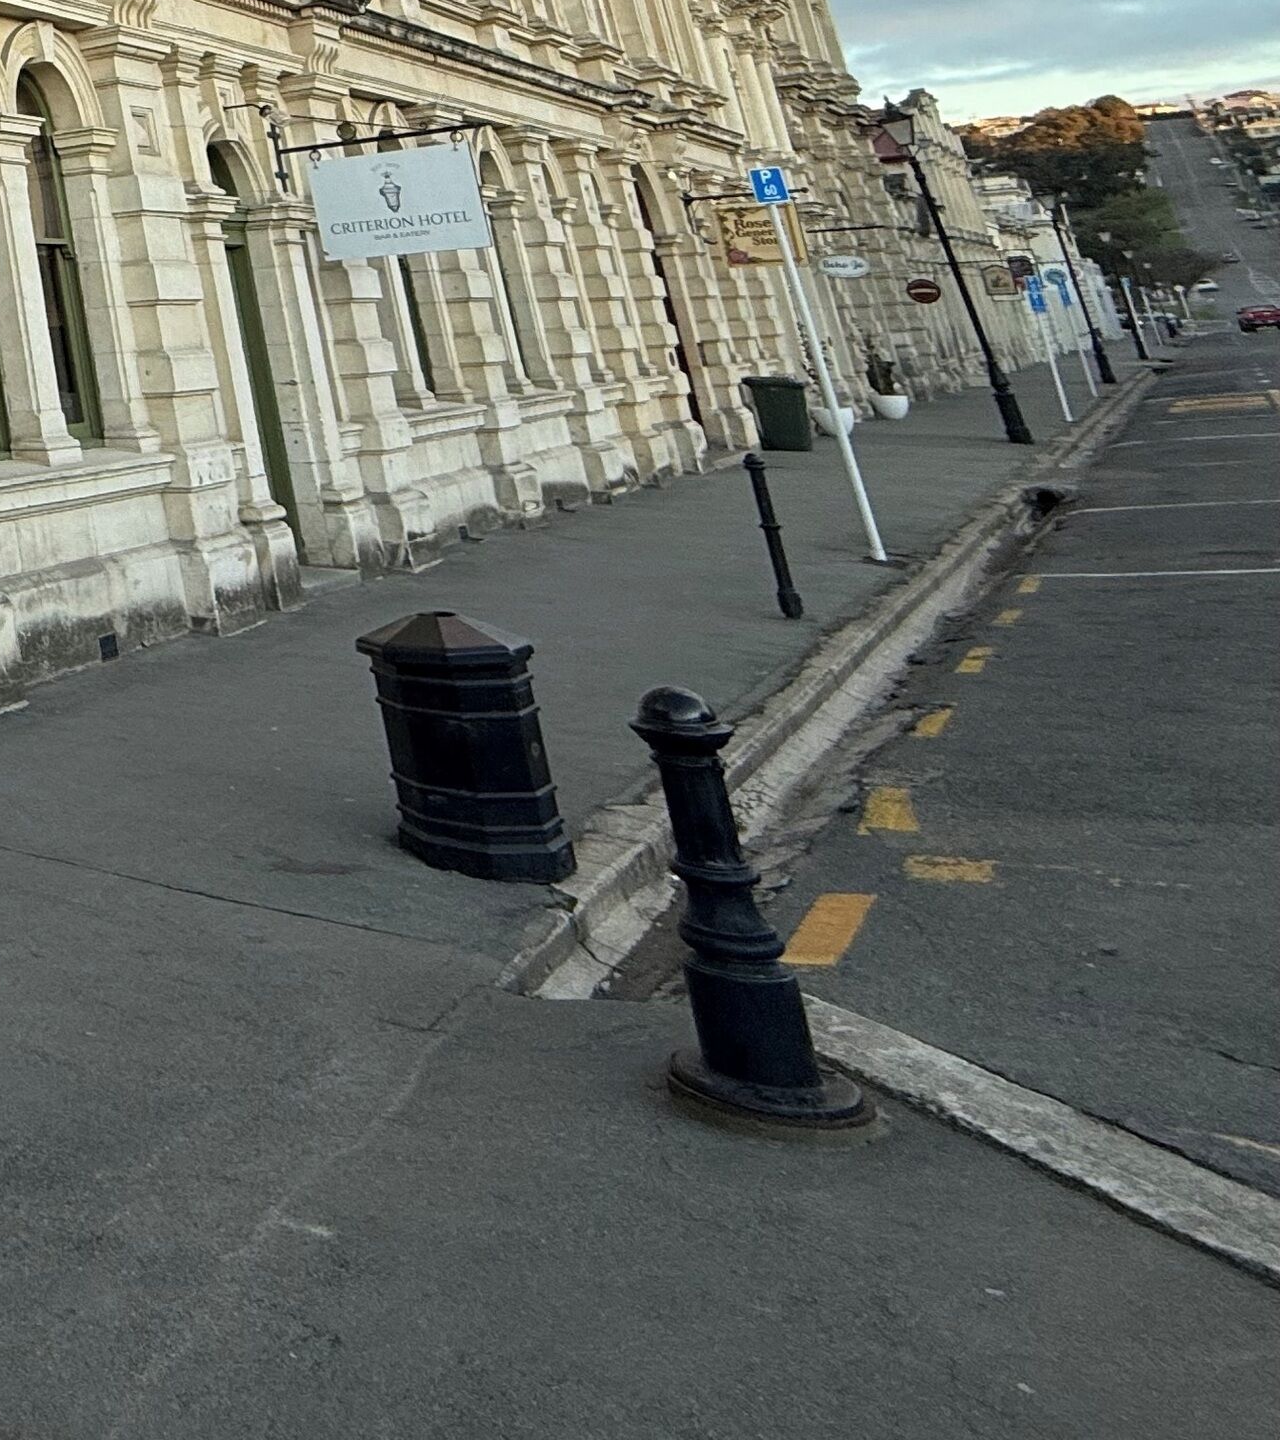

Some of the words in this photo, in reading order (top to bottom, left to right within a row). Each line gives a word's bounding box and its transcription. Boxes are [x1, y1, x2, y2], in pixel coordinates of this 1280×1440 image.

[759, 170, 772, 184] P
[330, 215, 415, 236] CRITERION
[419, 210, 472, 227] HOTEL
[374, 233, 391, 241] BAR
[400, 230, 431, 239] EATERY
